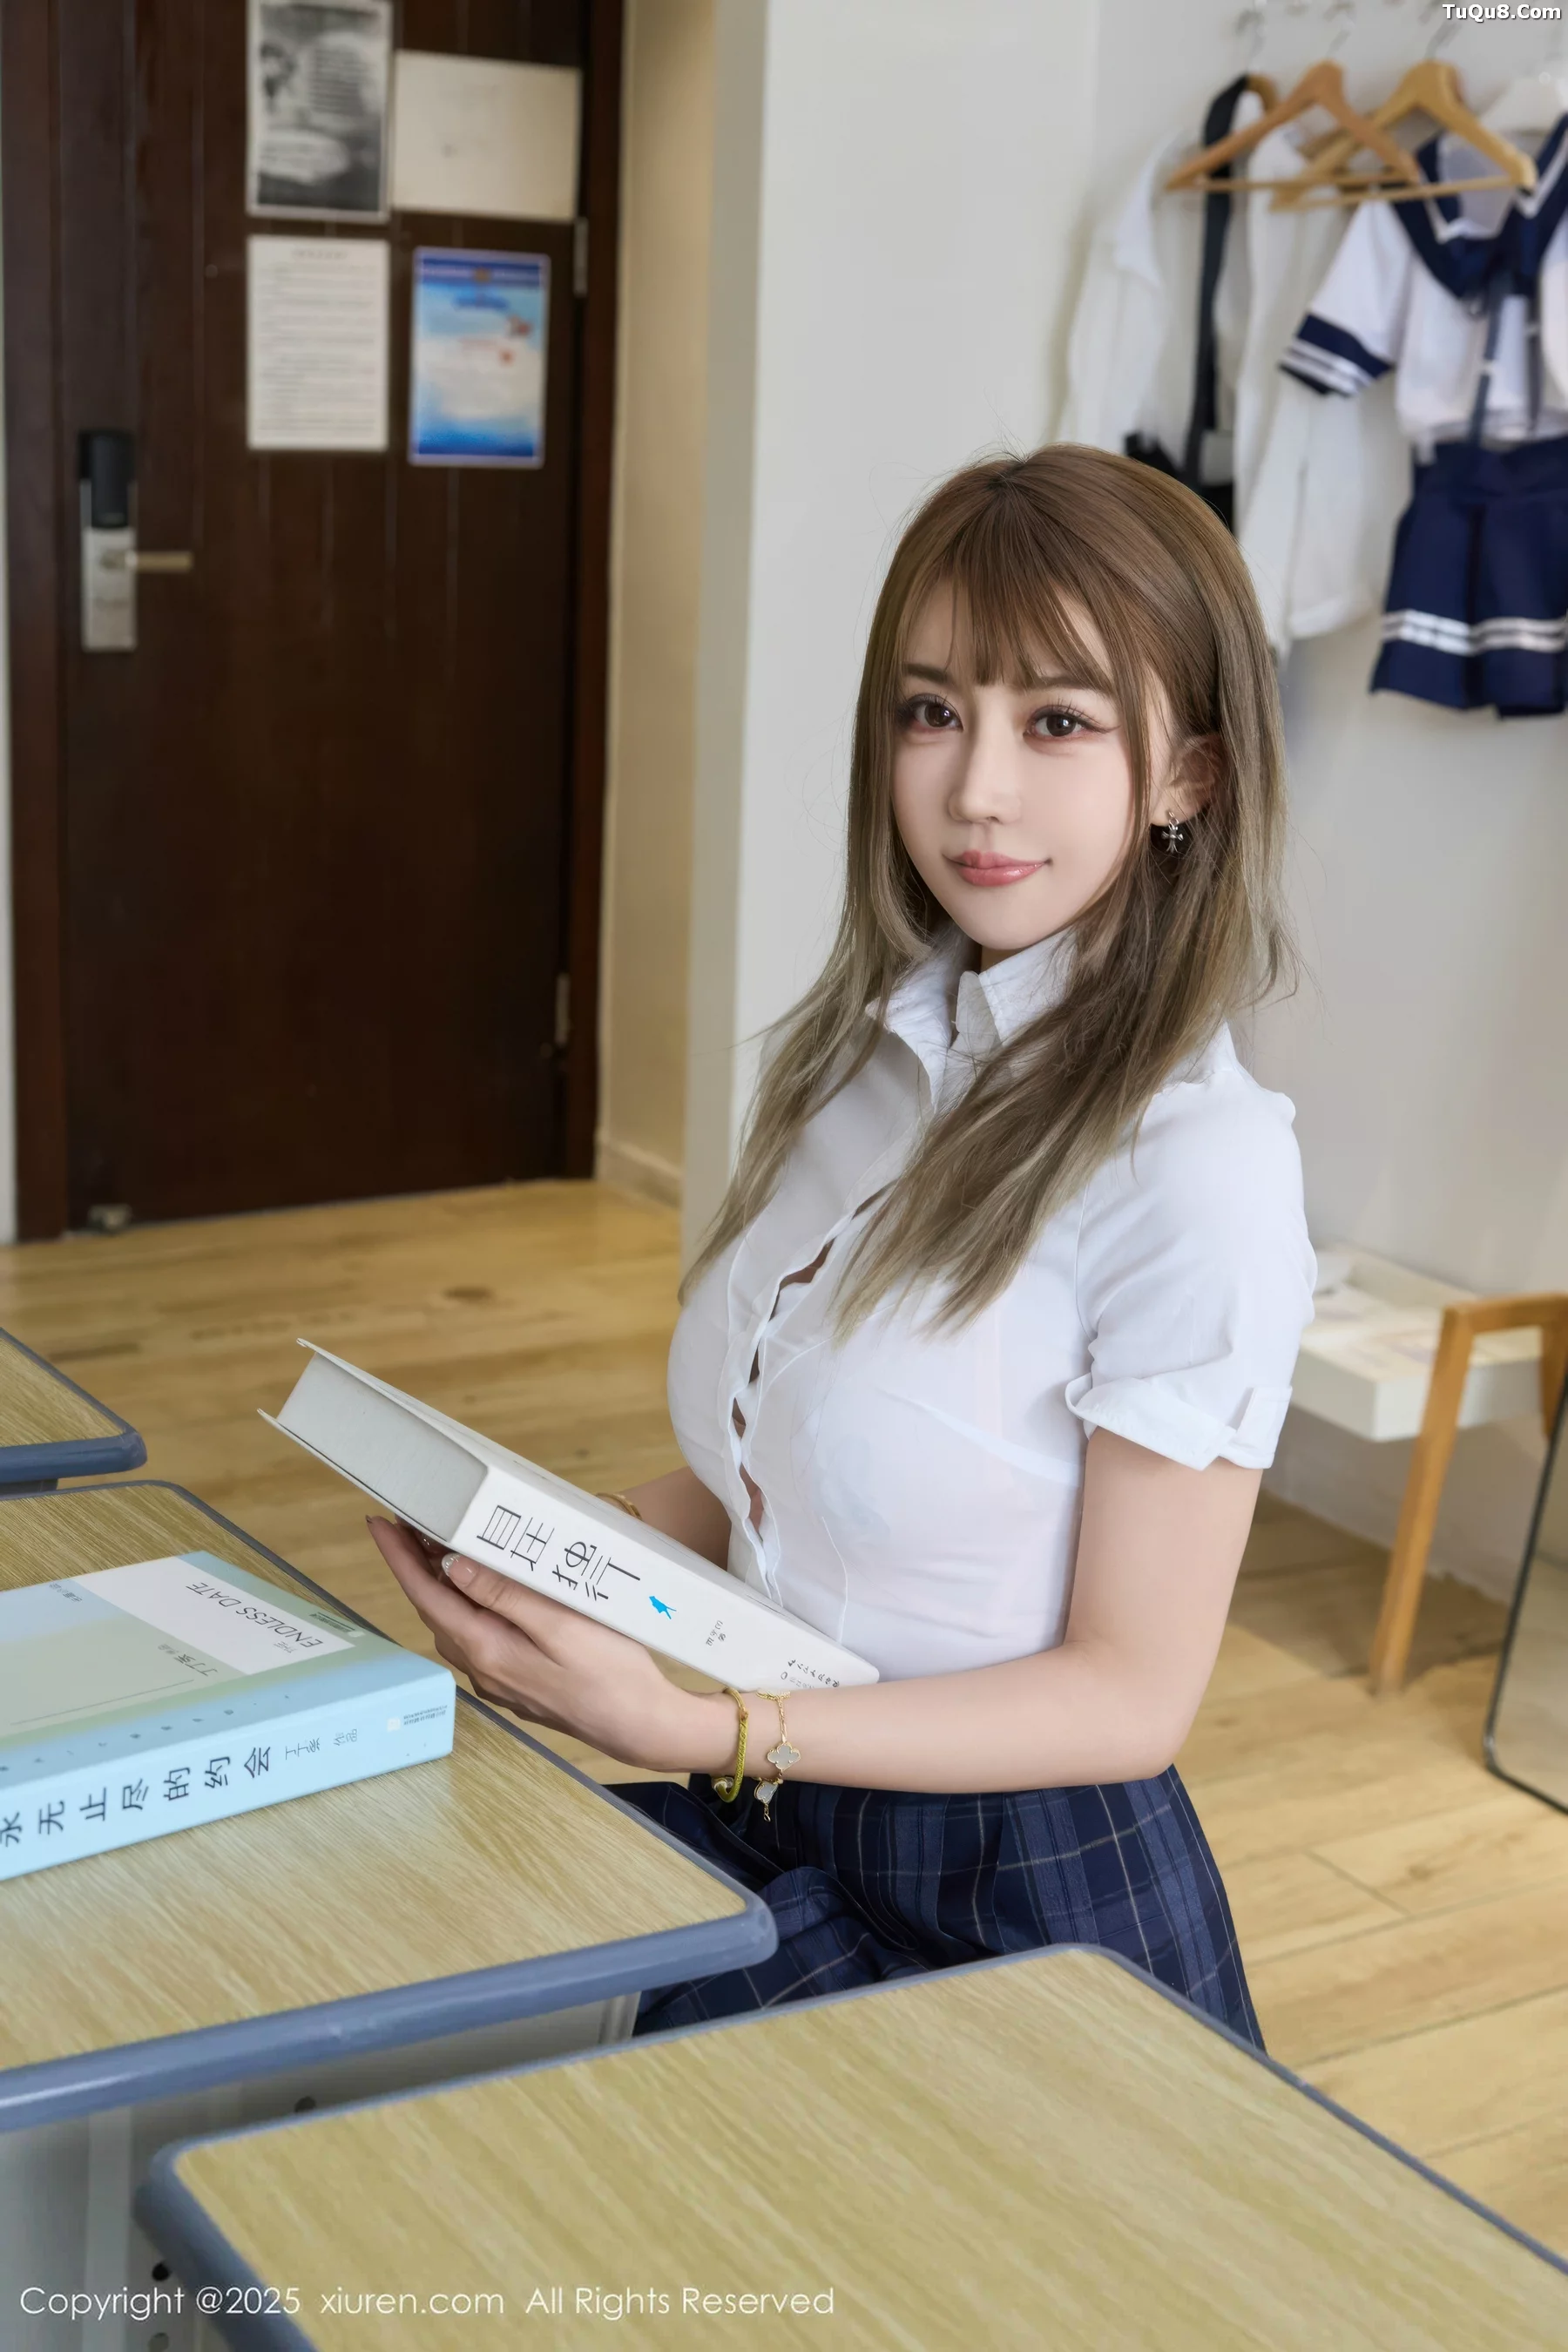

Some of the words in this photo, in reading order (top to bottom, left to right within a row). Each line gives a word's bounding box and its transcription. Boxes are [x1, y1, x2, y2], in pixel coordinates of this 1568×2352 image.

[476, 1504, 641, 1602] 自在独行
[185, 1581, 244, 1619] DATE
[234, 1605, 324, 1648] ENDLESS
[0, 1746, 272, 1848] 永无止尽的约会
